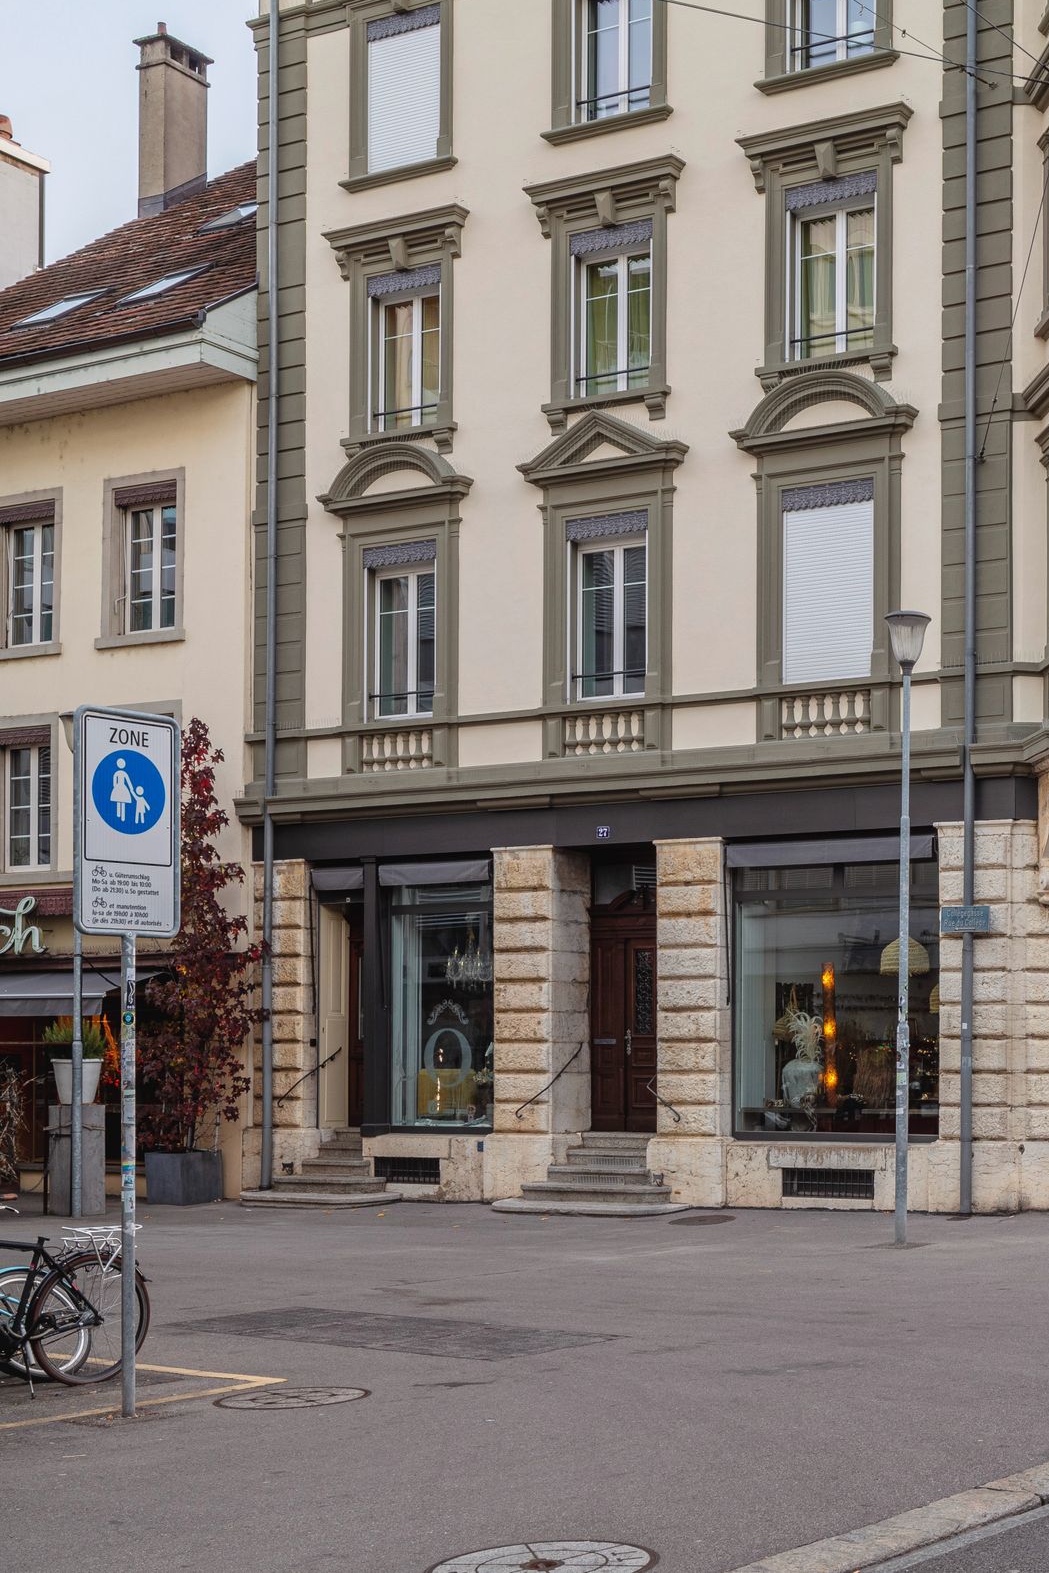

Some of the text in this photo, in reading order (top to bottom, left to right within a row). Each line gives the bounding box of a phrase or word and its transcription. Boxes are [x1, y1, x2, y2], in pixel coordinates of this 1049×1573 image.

[109, 727, 149, 748] ZONE
[598, 828, 608, 837] 27
[115, 872, 150, 881] Güterumschlag
